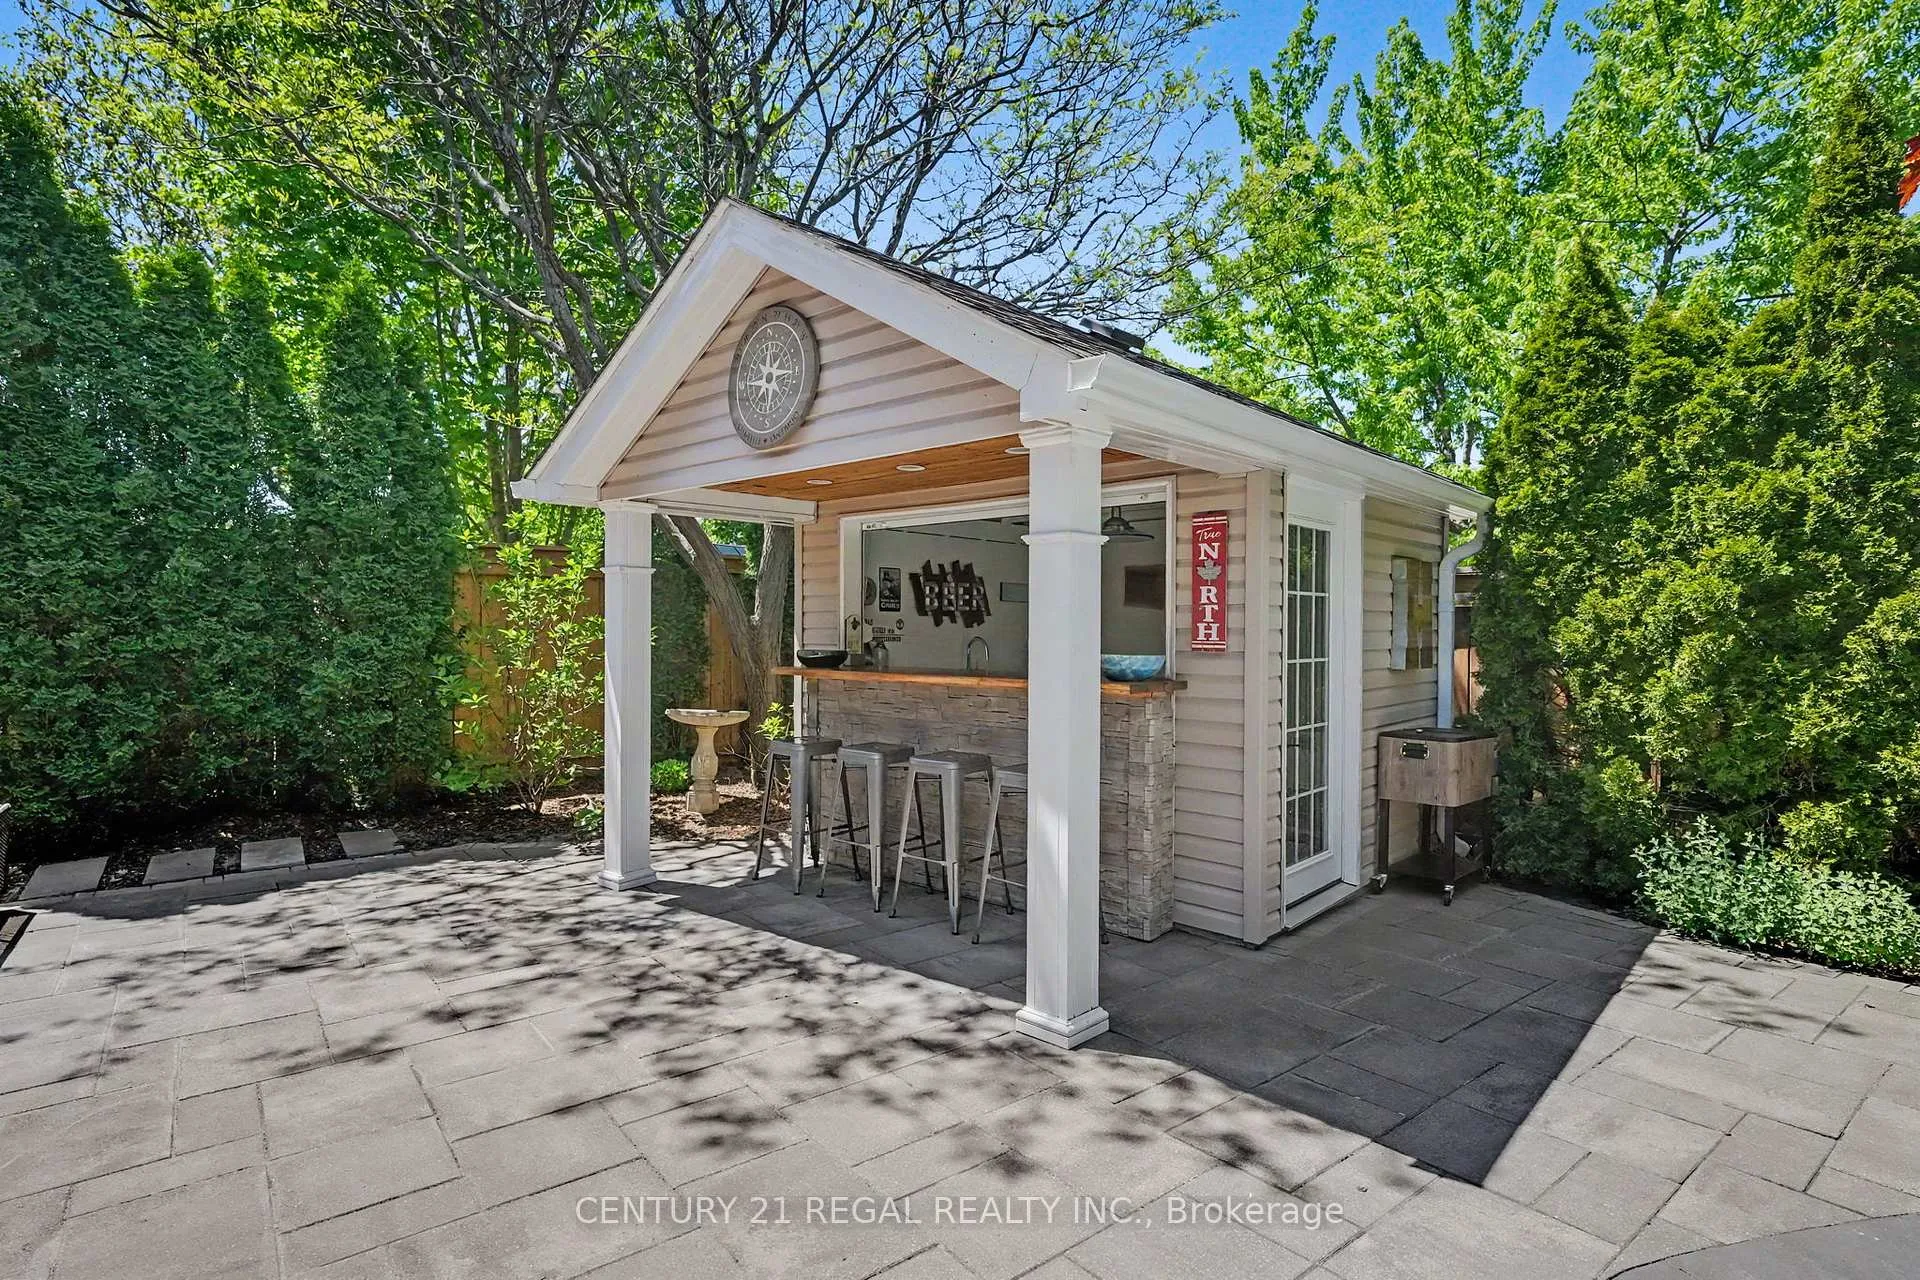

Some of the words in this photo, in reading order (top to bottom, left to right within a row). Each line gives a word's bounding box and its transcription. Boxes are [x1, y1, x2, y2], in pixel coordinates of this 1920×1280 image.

[1196, 527, 1222, 541] True
[924, 582, 985, 611] BEER
[1196, 543, 1220, 641] NRTH
